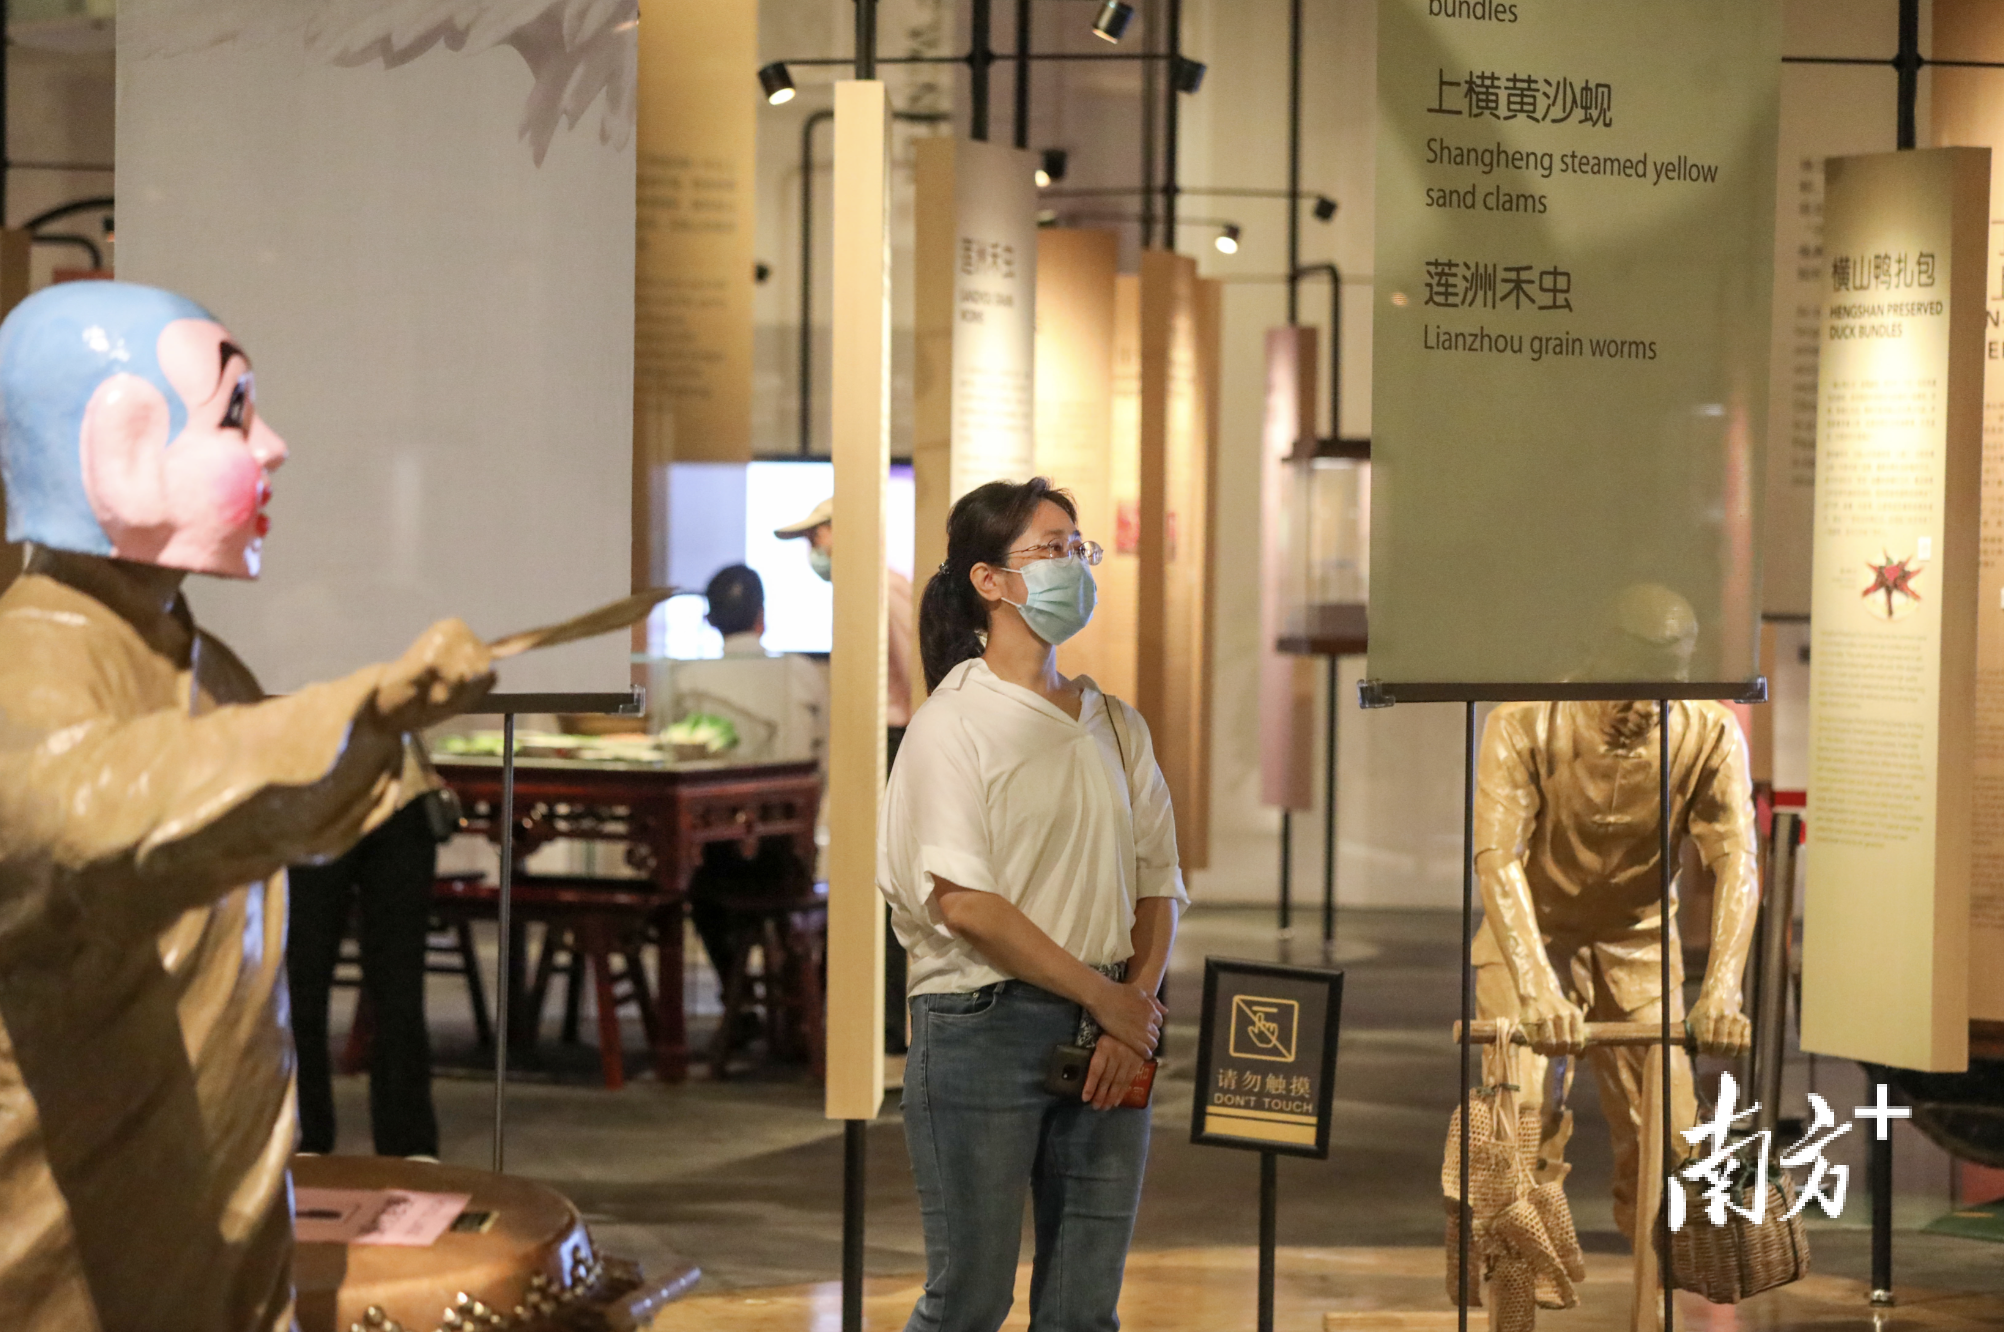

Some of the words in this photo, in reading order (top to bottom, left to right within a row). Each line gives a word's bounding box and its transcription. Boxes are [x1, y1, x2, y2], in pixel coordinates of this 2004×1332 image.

[1426, 67, 1613, 128] 上横黄沙蚬
[1426, 138, 1553, 178] Shangheng
[1560, 151, 1647, 178] steamed
[1653, 155, 1718, 186] yellow
[1425, 183, 1476, 210] sand
[1482, 185, 1547, 214] clams
[1424, 258, 1573, 313] 莲洲禾虫
[1832, 251, 1936, 292] 横山鸭扎包
[1829, 303, 1885, 319] HENGSHAN
[1887, 301, 1944, 317] PRESERVED
[1424, 324, 1522, 353] Lianzhou
[1529, 331, 1583, 361] grain
[1589, 338, 1657, 360] worms
[1829, 324, 1856, 340] DUCK
[1859, 321, 1903, 338] BUNDLES
[1217, 1068, 1312, 1099] 请勿触摸
[1213, 1092, 1258, 1107] DON'T
[1264, 1096, 1314, 1114] TOUCH
